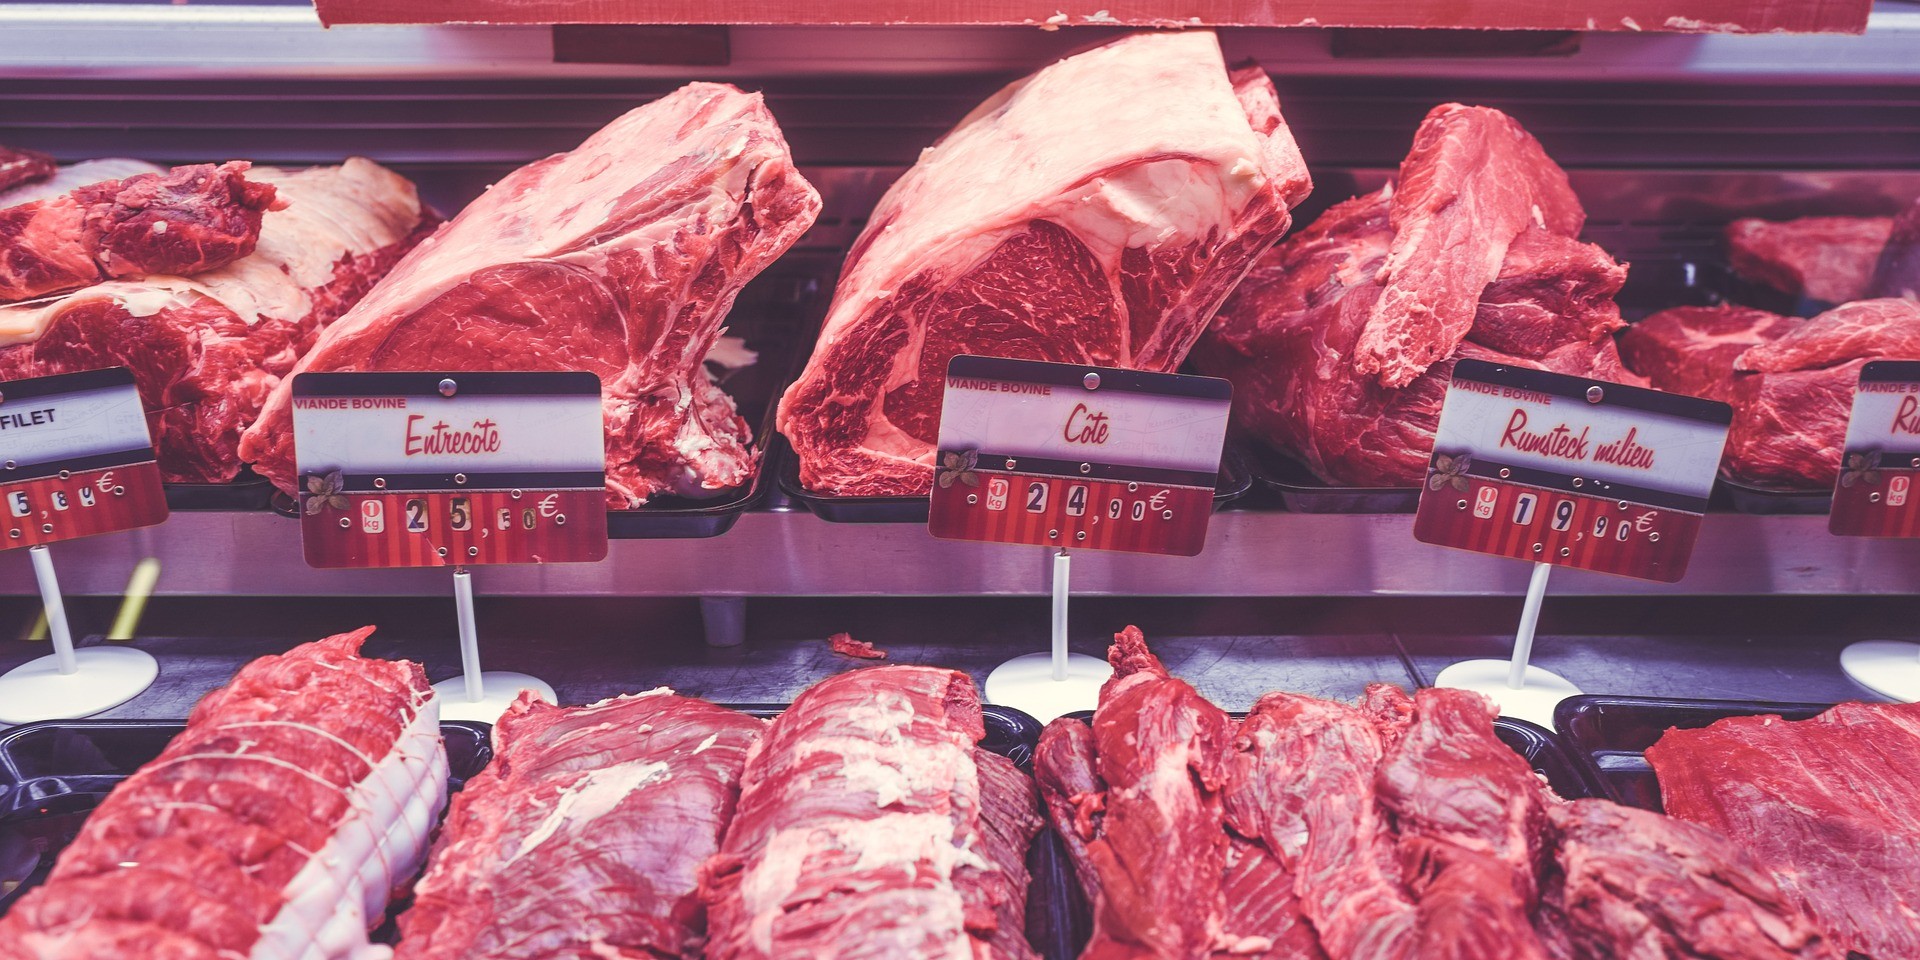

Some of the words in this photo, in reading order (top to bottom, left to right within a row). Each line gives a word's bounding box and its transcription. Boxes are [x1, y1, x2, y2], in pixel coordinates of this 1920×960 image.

[948, 379, 997, 391] VIANDE
[1001, 383, 1051, 395] BOVINE
[1451, 379, 1499, 395] VIANDE
[1502, 387, 1552, 405] BOVINE
[1859, 384, 1906, 393] VIANDE
[294, 398, 348, 409] VIANDE
[352, 398, 406, 409] BOVINE
[0, 408, 55, 430] FILET
[1064, 403, 1109, 444] Côte
[405, 414, 501, 456] Entrecôte
[1500, 408, 1590, 460] Rumsteck
[1593, 427, 1655, 469] milieu
[364, 518, 379, 530] kg
